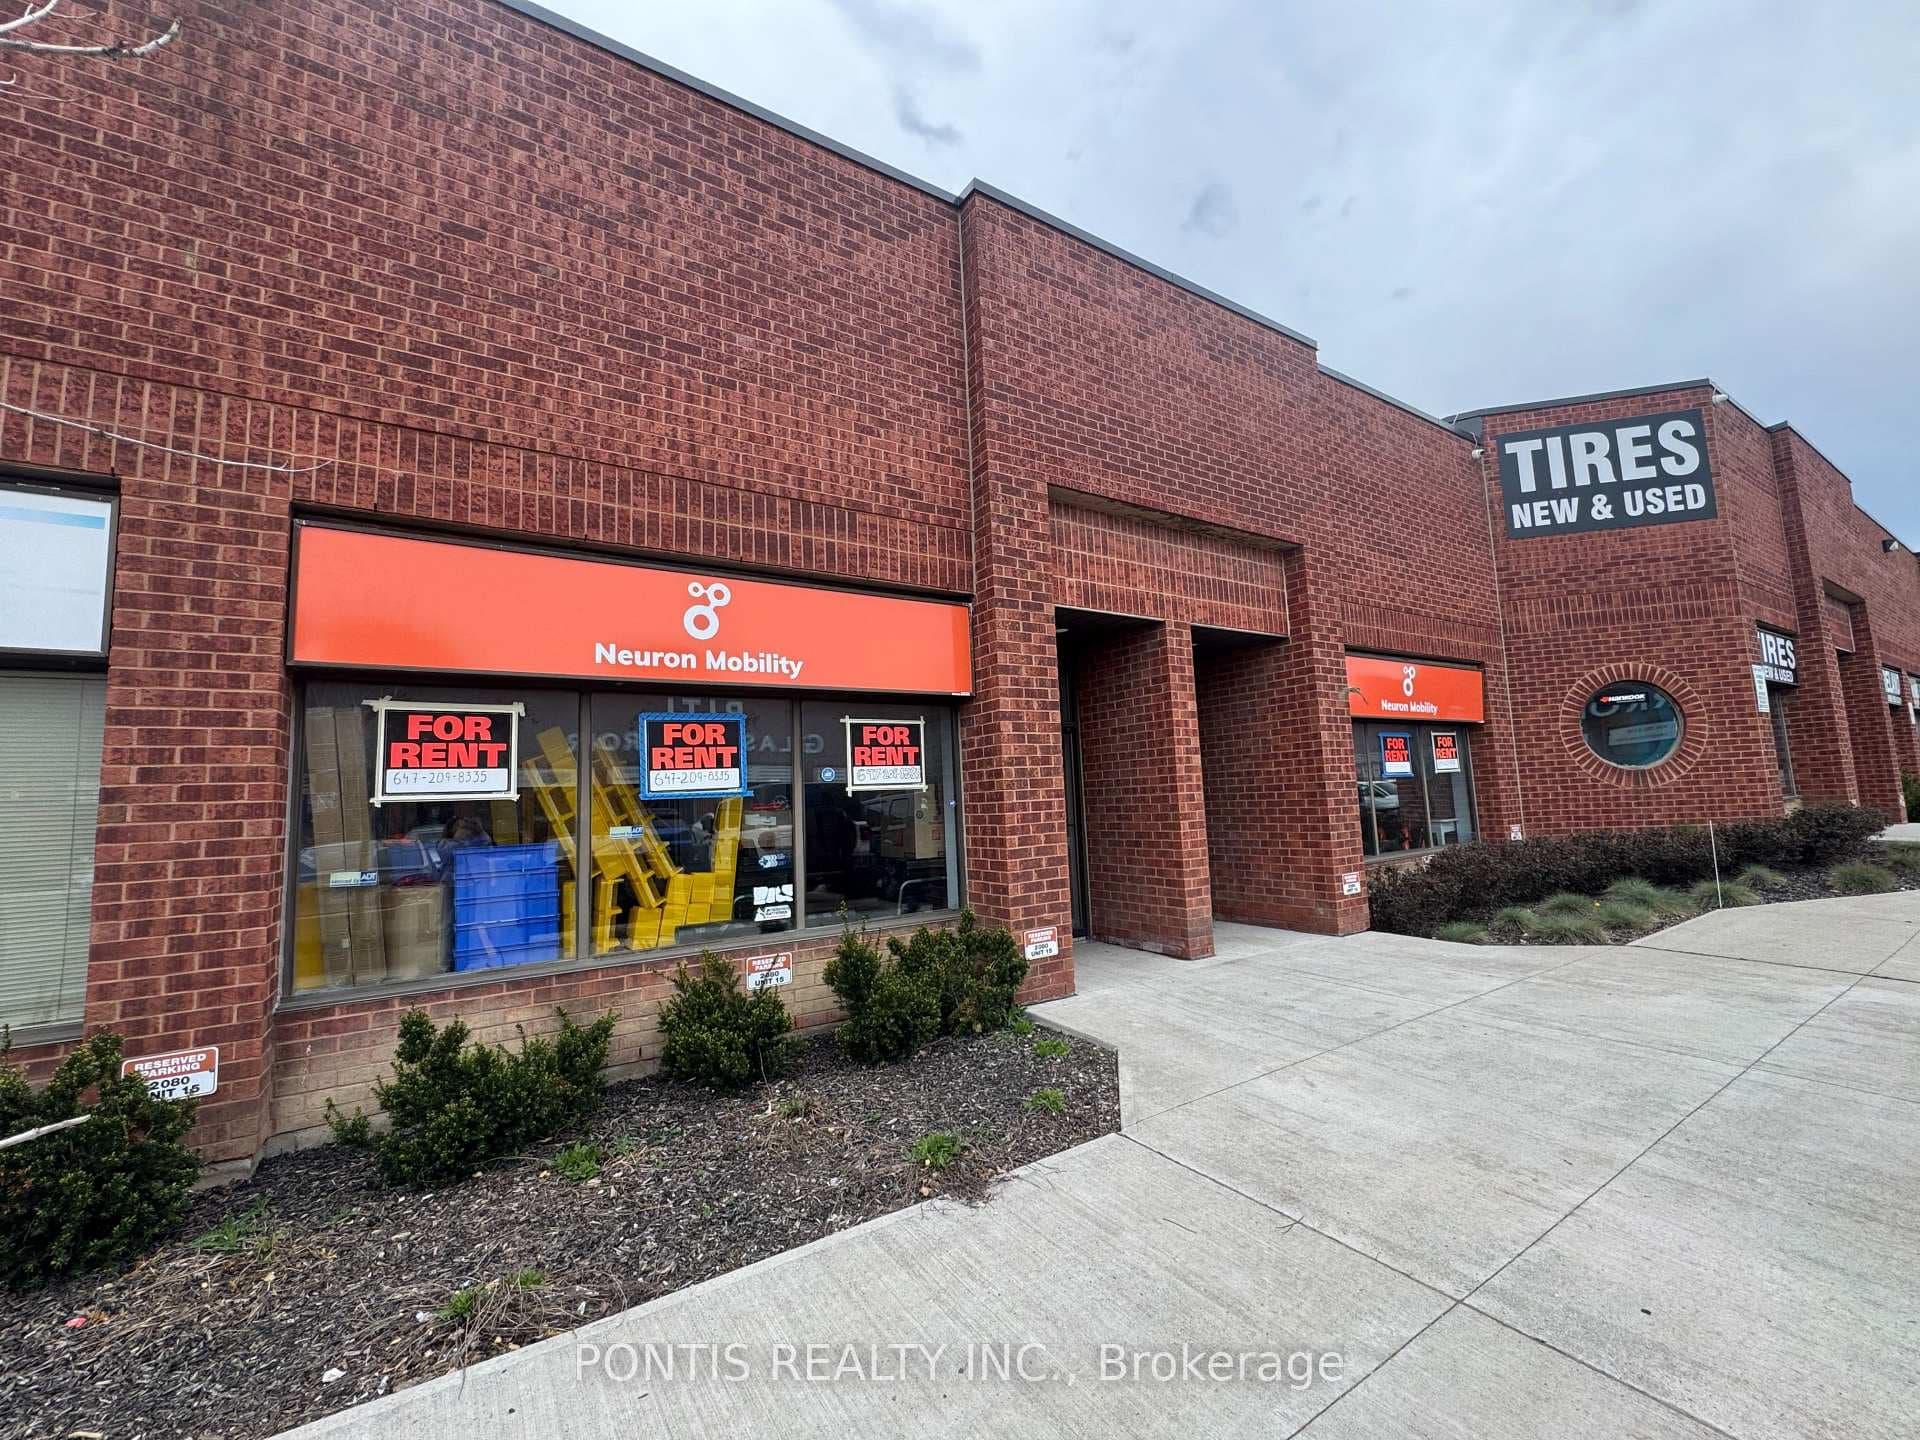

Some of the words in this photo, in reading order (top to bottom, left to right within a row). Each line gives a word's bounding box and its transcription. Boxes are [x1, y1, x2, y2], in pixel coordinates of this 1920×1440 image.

[1505, 420, 1700, 493] TIRES
[1512, 497, 1579, 529] NEW
[1590, 494, 1614, 520] &
[1623, 483, 1706, 517] USED
[1757, 631, 1796, 670] IRES
[595, 642, 696, 669] Neuron
[705, 649, 804, 680] Mobility
[1381, 700, 1409, 711] Neuron
[1410, 701, 1438, 716] Mobility
[407, 714, 492, 741] FOR
[663, 723, 726, 745] FOR
[862, 726, 910, 745] FOR
[1386, 737, 1404, 749] FOR
[1437, 736, 1453, 747] FOR
[390, 742, 507, 768] RENT
[652, 746, 737, 769] RENT
[854, 746, 919, 766] RENT
[1384, 750, 1408, 762] RENT
[1436, 748, 1457, 759] RENT
[393, 771, 487, 785] 647-209-8335
[134, 1053, 207, 1071] RESERVED
[140, 1062, 200, 1078] PARKING
[148, 1076, 190, 1090] 2080
[149, 1088, 176, 1099] NIT
[182, 1084, 200, 1095] 15
